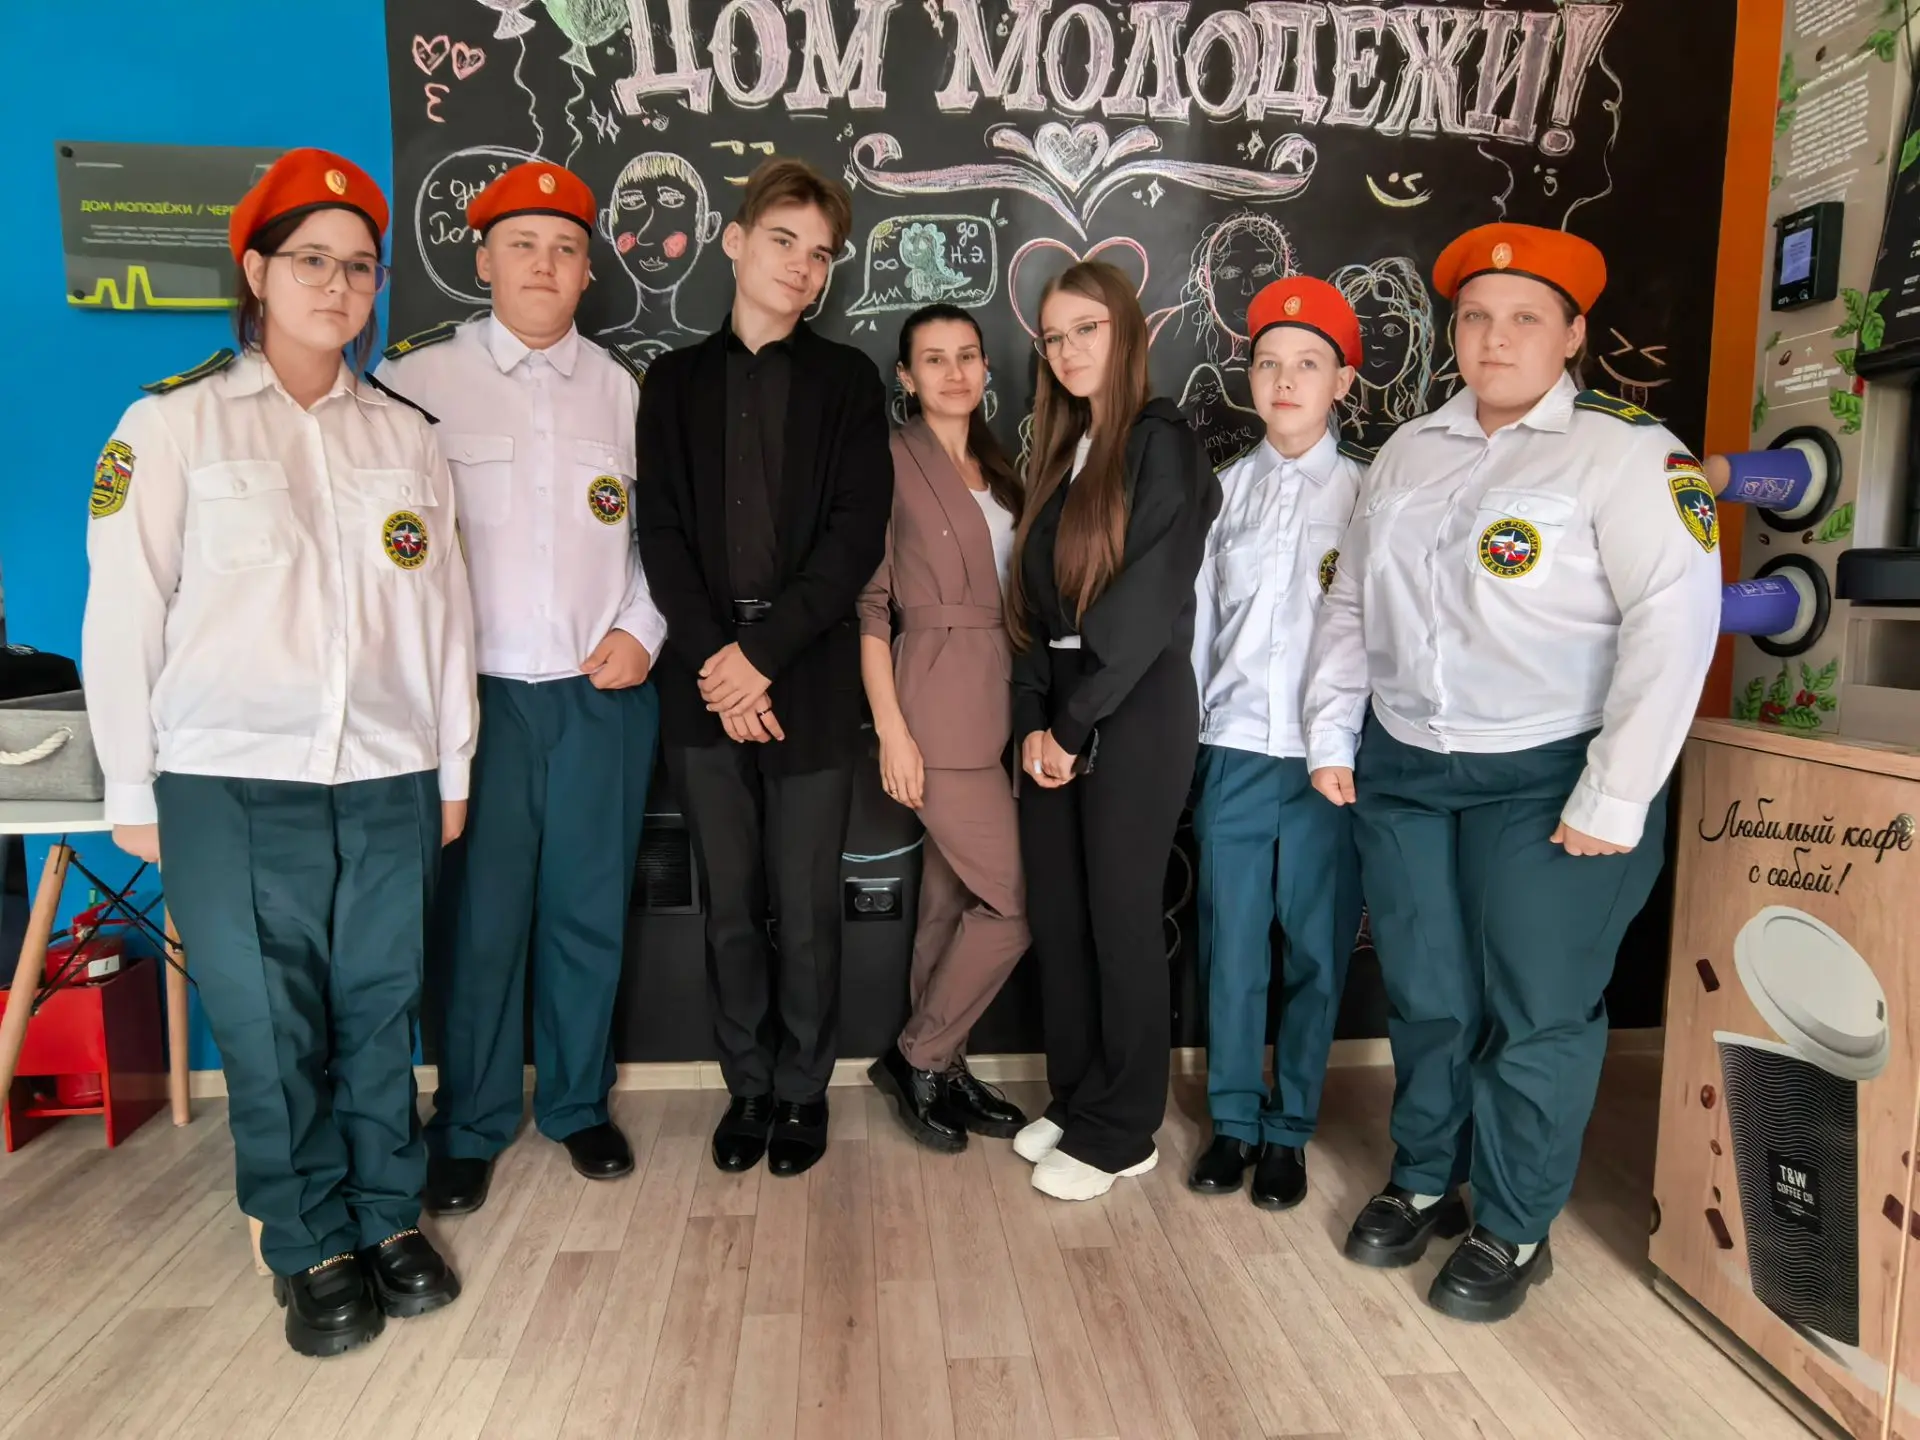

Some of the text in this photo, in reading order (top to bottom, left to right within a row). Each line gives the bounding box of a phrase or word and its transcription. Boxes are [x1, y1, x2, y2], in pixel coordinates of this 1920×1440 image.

[611, 0, 900, 116] ДОМ
[80, 199, 112, 213] ДОМ
[1699, 797, 1836, 842] Любимый
[1779, 1164, 1807, 1190] T&W
